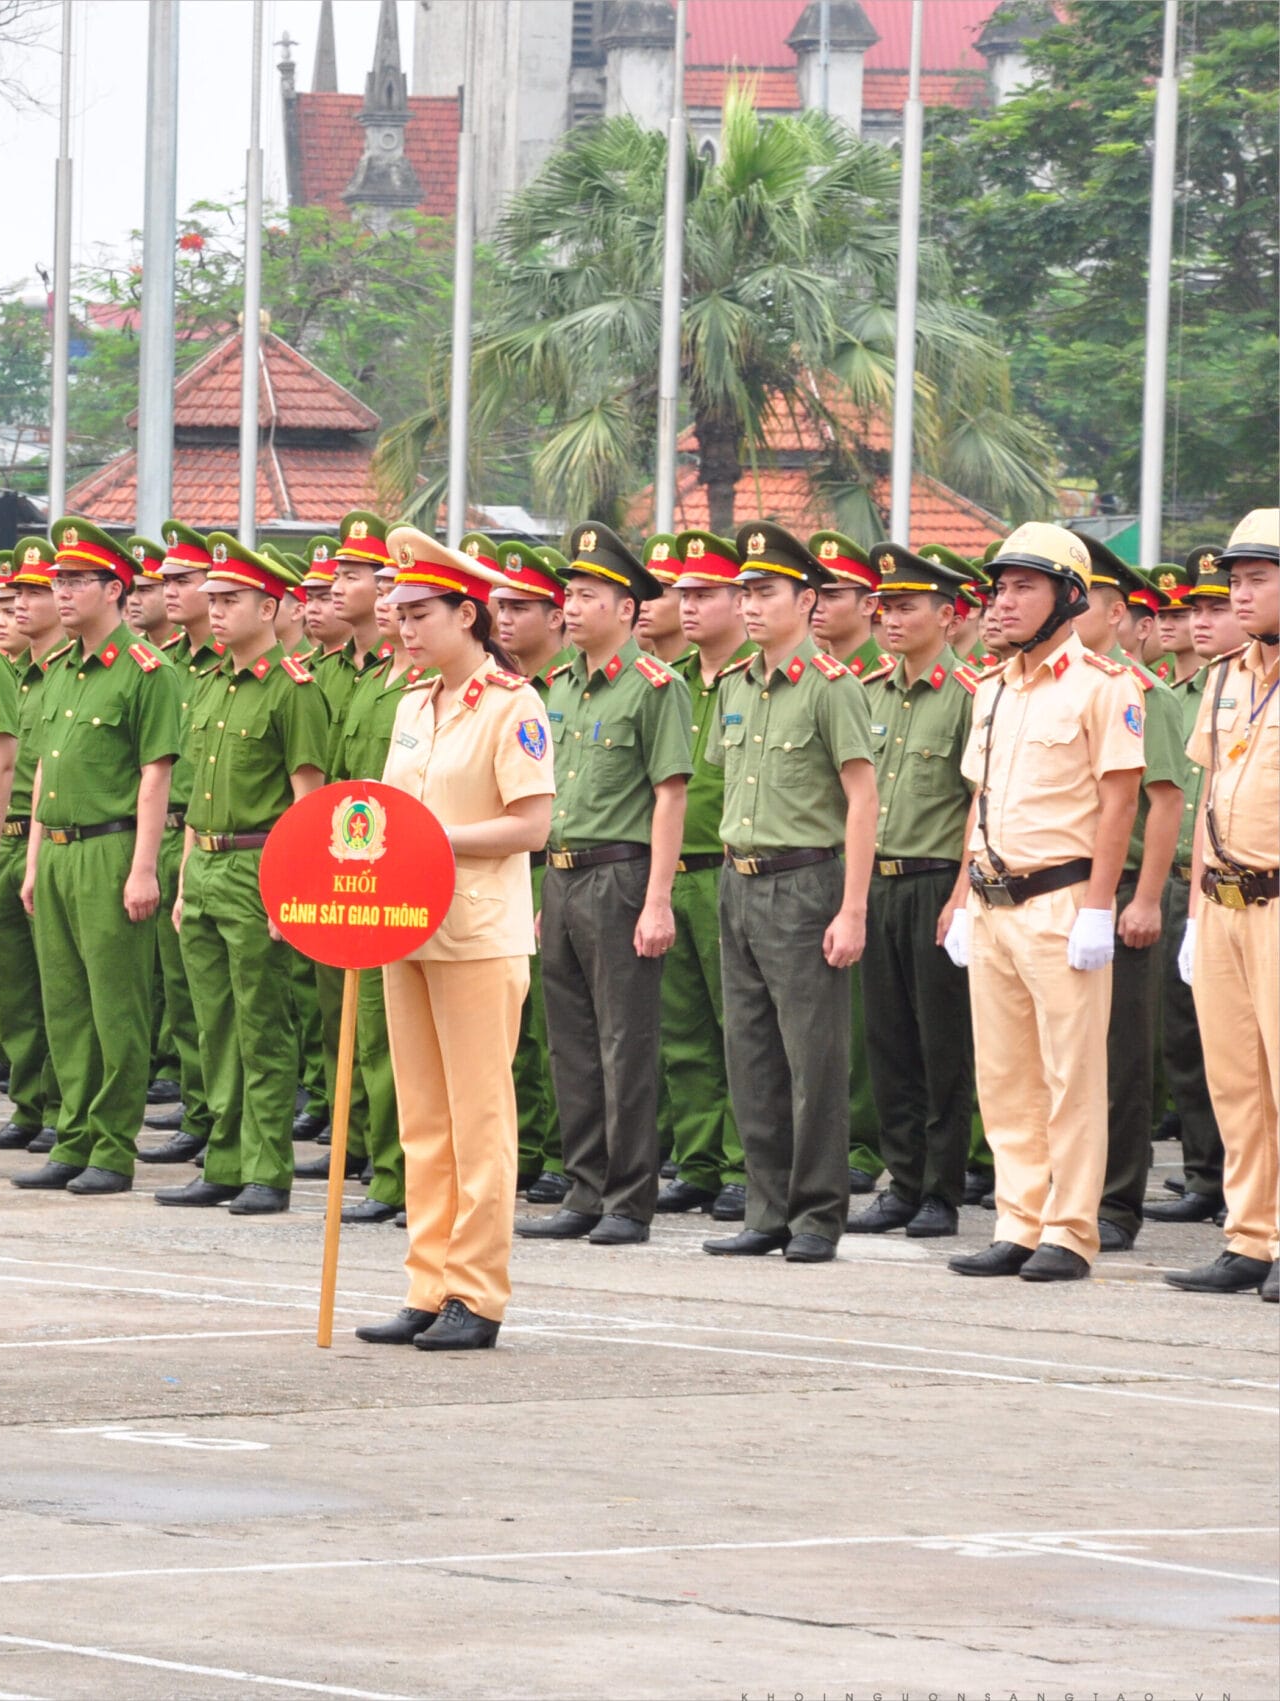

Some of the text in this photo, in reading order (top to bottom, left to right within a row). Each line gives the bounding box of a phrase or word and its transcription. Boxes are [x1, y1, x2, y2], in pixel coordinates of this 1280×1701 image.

[333, 868, 377, 894] KHỐI
[280, 896, 428, 928] CẢNH SÁT GIAO THÔNG
